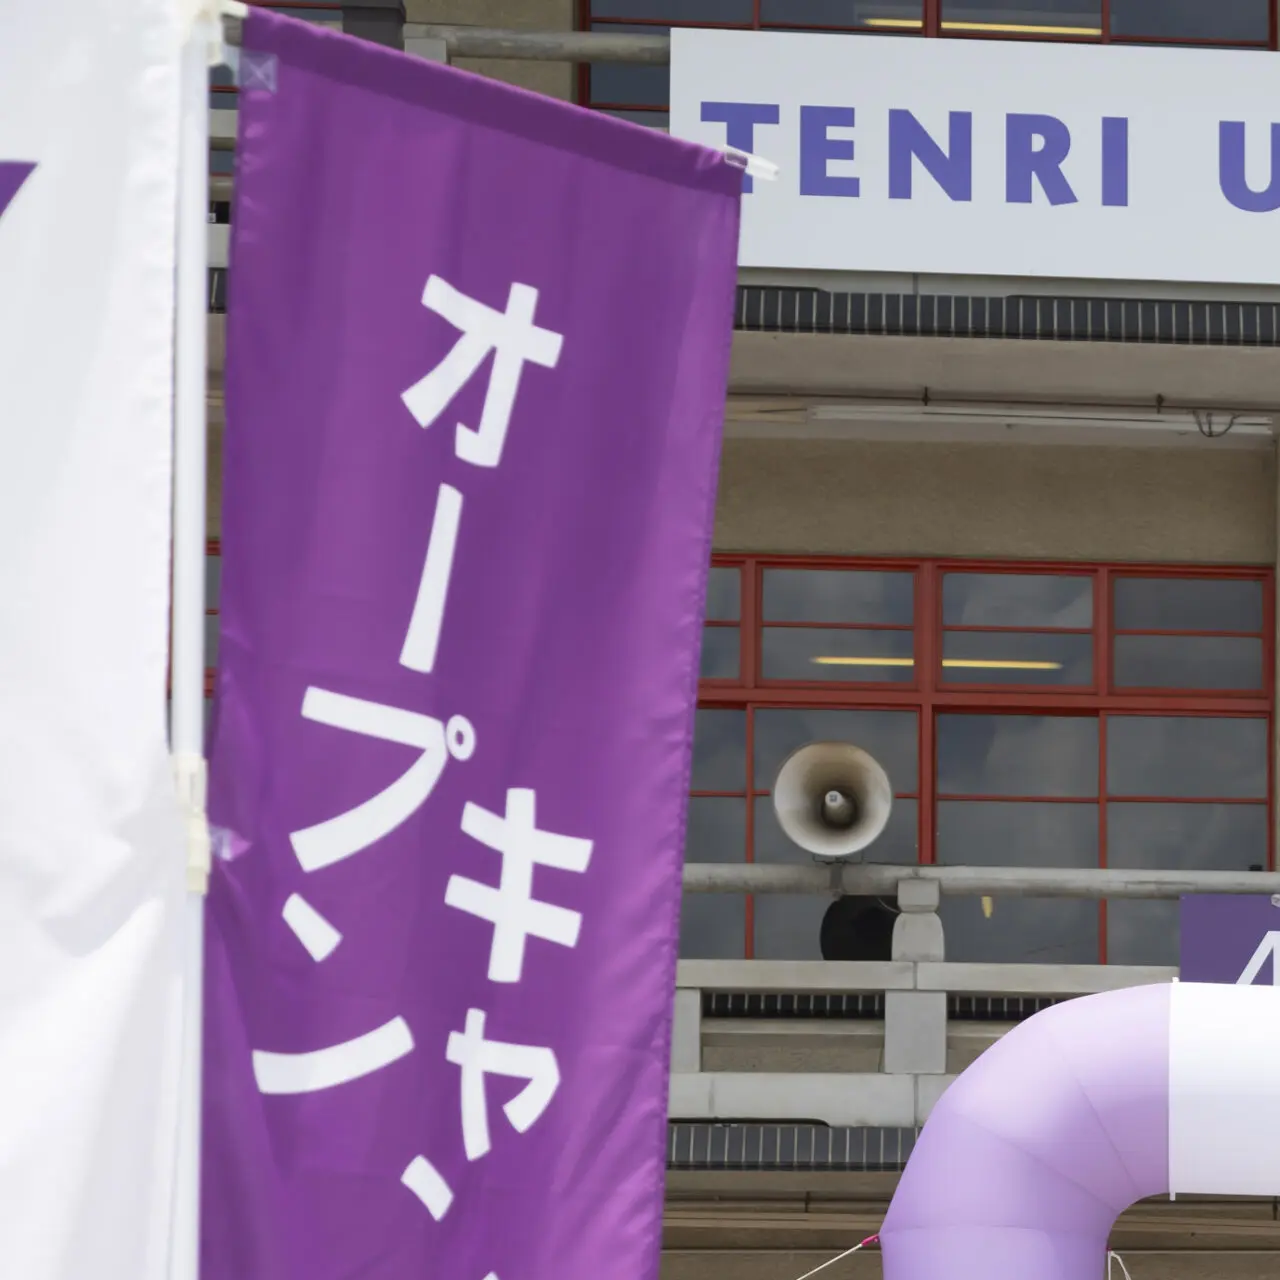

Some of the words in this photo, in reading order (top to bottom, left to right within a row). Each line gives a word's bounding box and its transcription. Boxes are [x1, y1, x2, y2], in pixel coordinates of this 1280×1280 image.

[699, 100, 1130, 208] TENRI
[252, 273, 564, 1096] オープン
